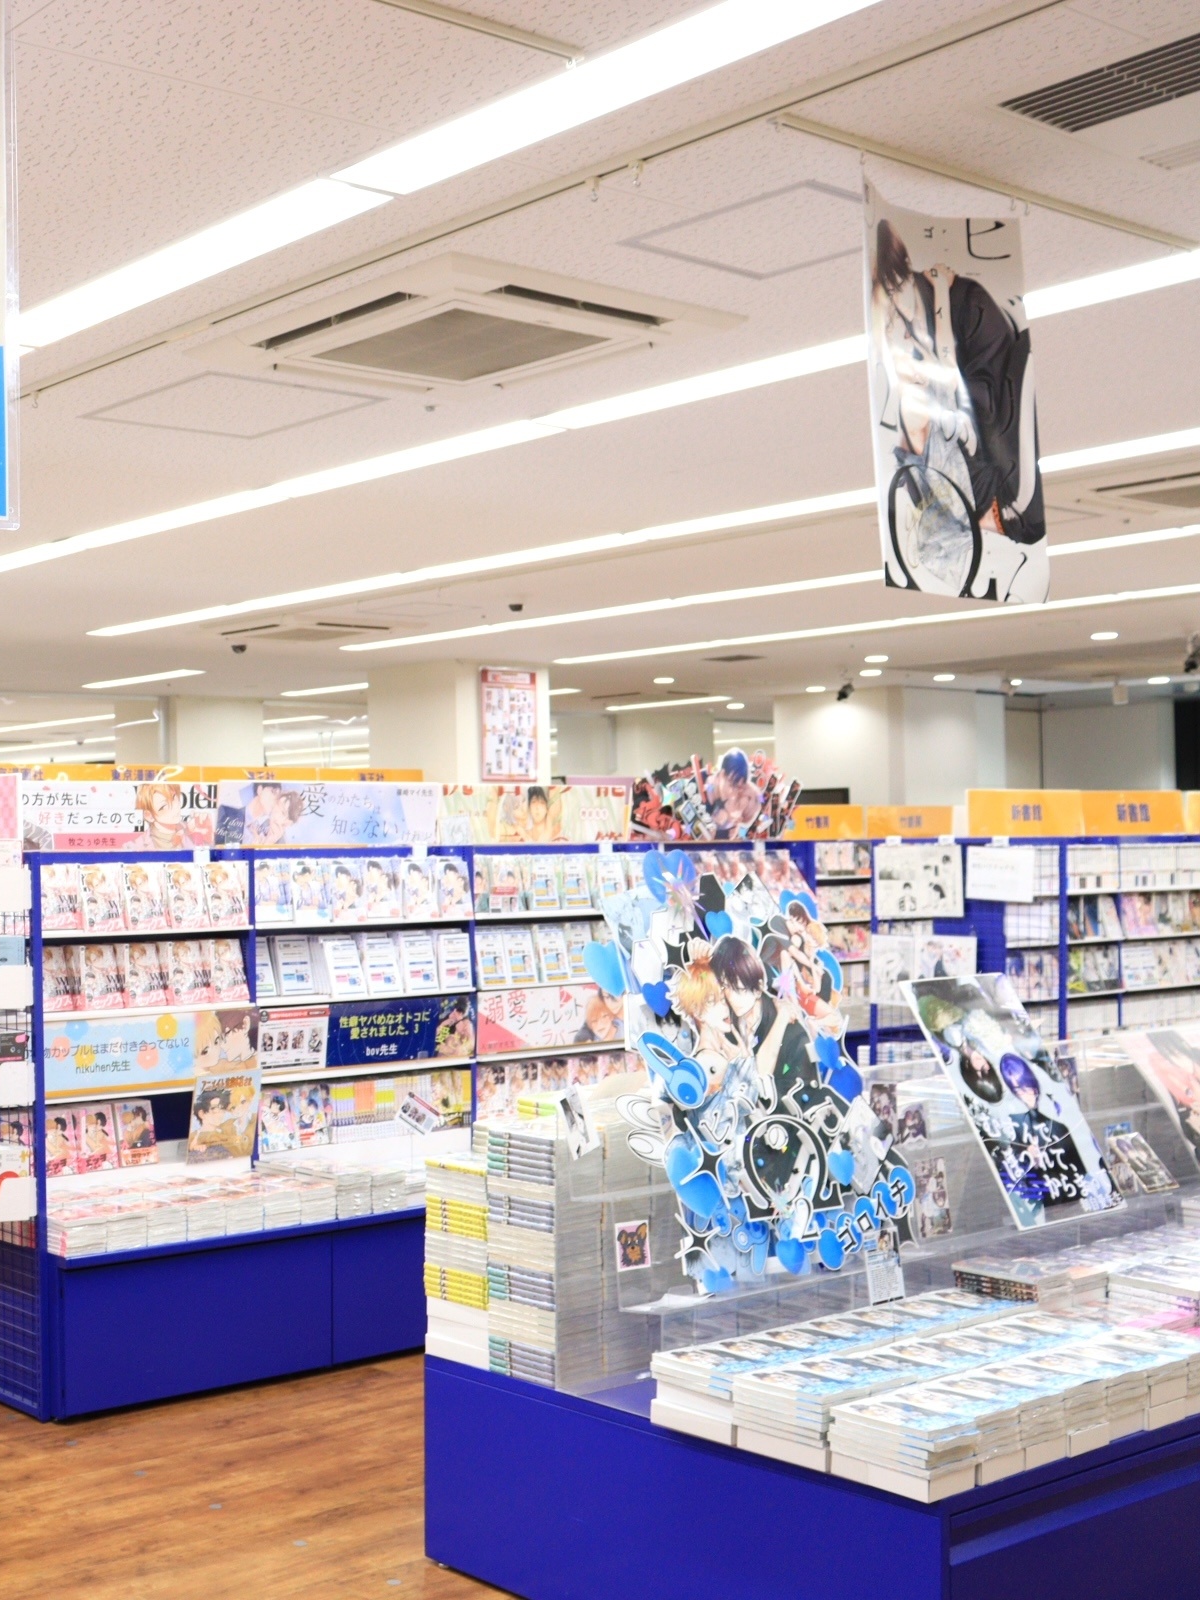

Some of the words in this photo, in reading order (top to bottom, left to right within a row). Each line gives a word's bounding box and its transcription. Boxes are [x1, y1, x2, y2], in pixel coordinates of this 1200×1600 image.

[38, 811, 143, 826] 好きだったので。
[484, 989, 528, 1025] 溺愛
[516, 997, 584, 1030] シークレット
[75, 1060, 131, 1074] nikuhen先生
